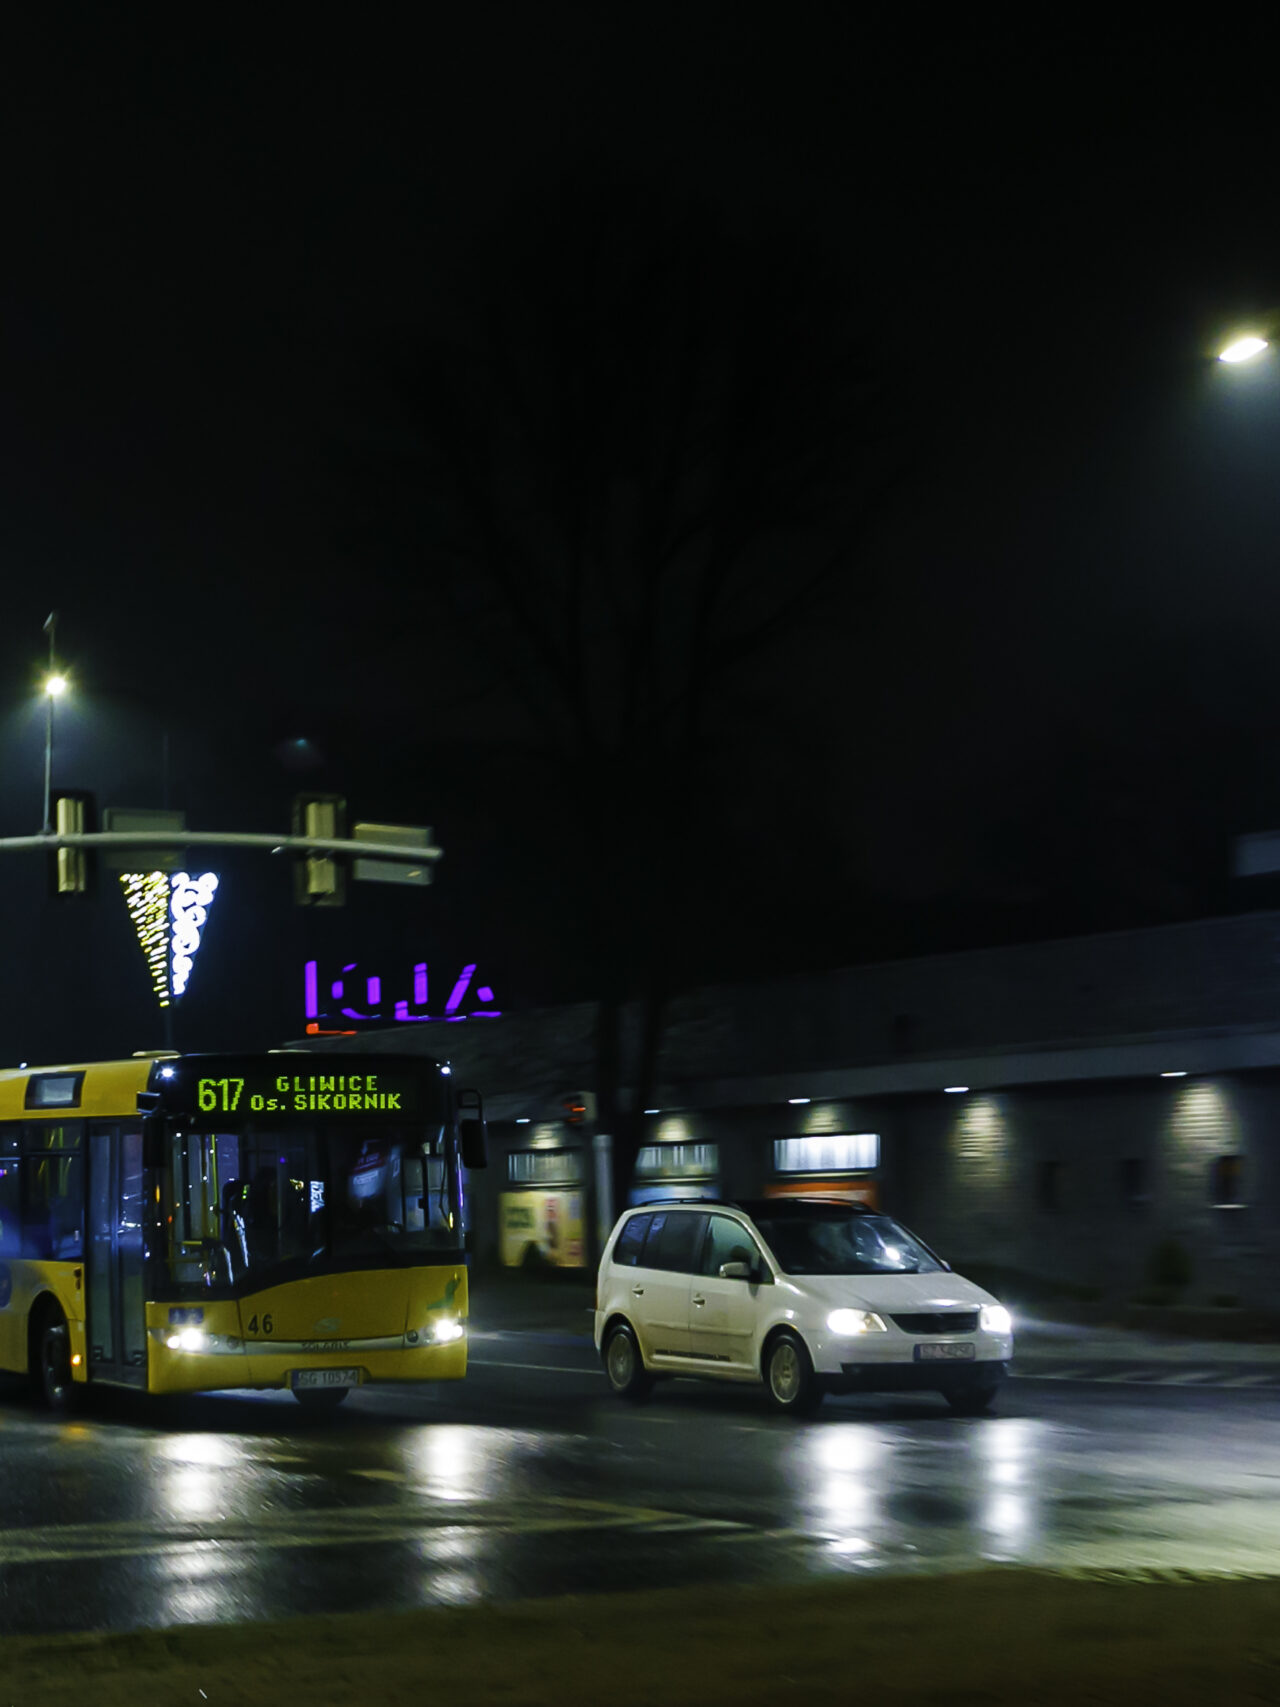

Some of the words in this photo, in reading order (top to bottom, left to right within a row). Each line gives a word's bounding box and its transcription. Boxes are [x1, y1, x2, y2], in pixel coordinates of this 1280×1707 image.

[276, 1076, 378, 1092] GLIWICE
[198, 1078, 245, 1111] 617
[250, 1094, 286, 1111] Os.
[294, 1093, 402, 1110] SIKORNIK
[248, 1313, 273, 1334] 46
[299, 1371, 317, 1385] SG
